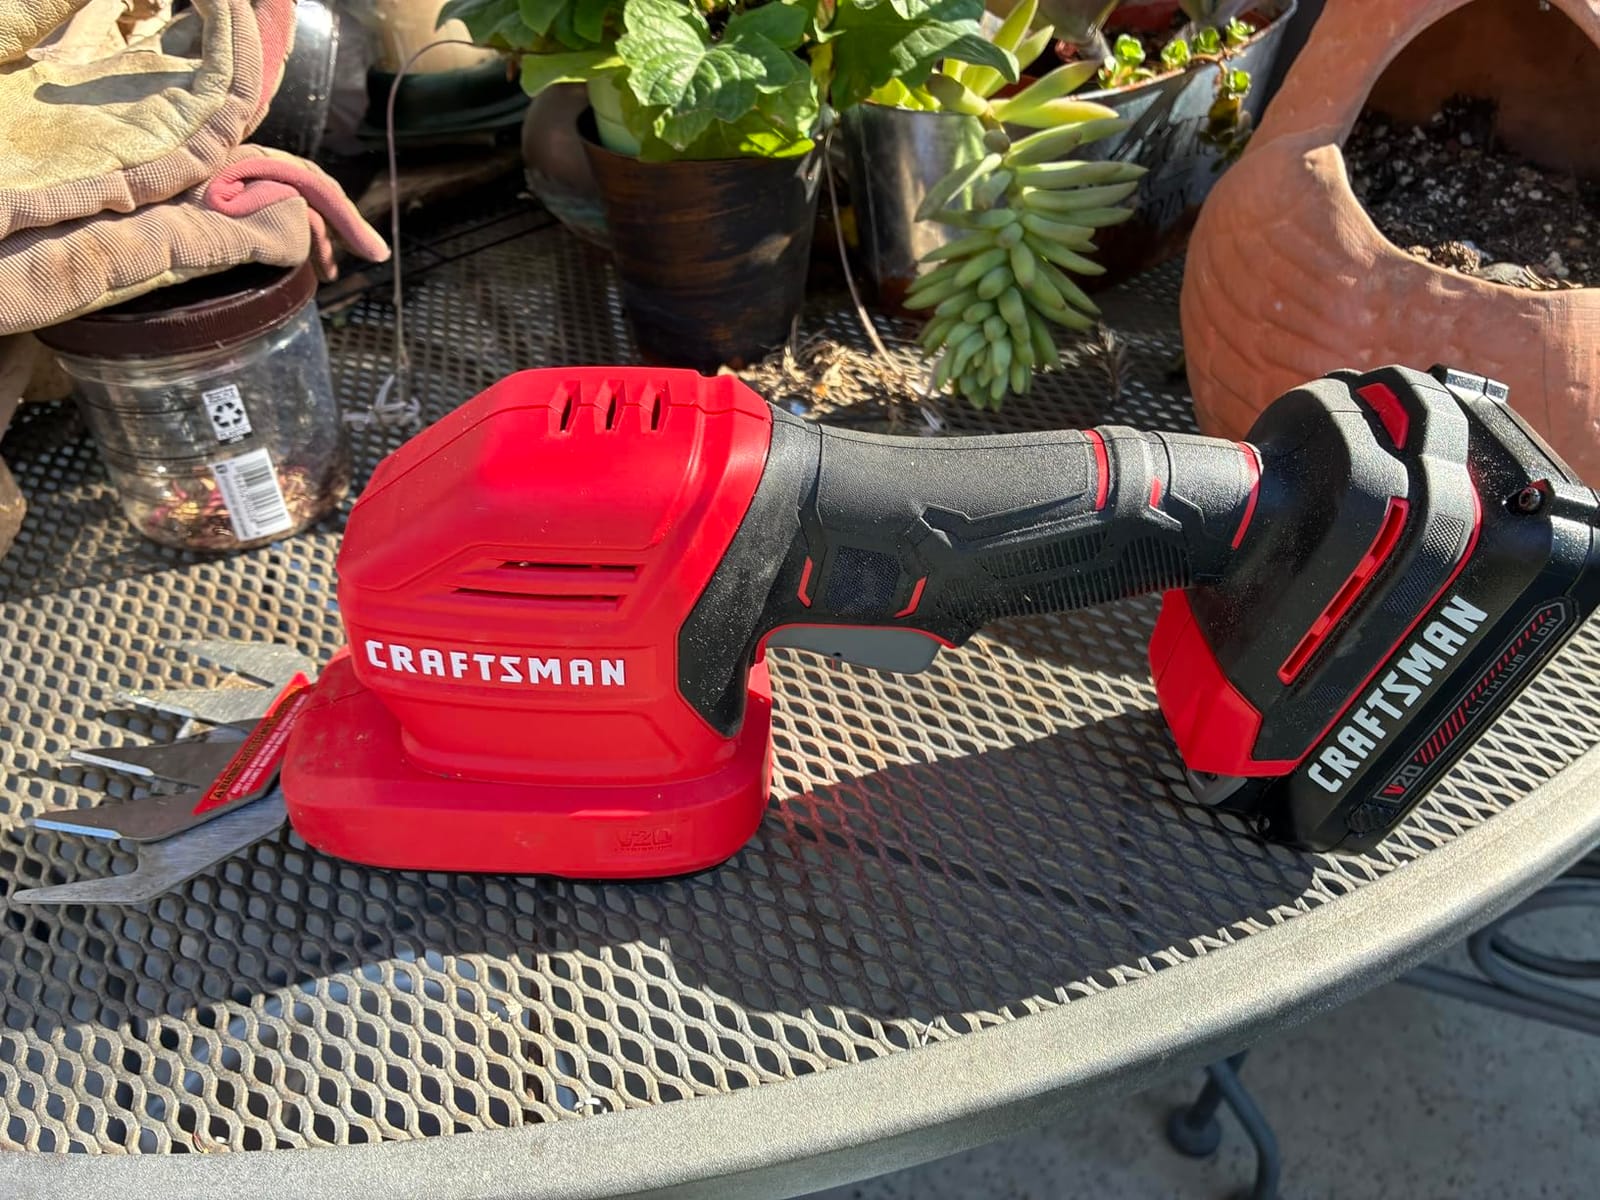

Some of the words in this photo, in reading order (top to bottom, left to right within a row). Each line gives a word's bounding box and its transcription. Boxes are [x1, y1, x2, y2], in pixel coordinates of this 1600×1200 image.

[365, 640, 625, 686] CRAFTSMAN
[1308, 595, 1488, 793] CRAFTSMAN
[1383, 764, 1424, 795] V20
[1466, 653, 1526, 715] LITHIUM
[1531, 617, 1558, 643] ION
